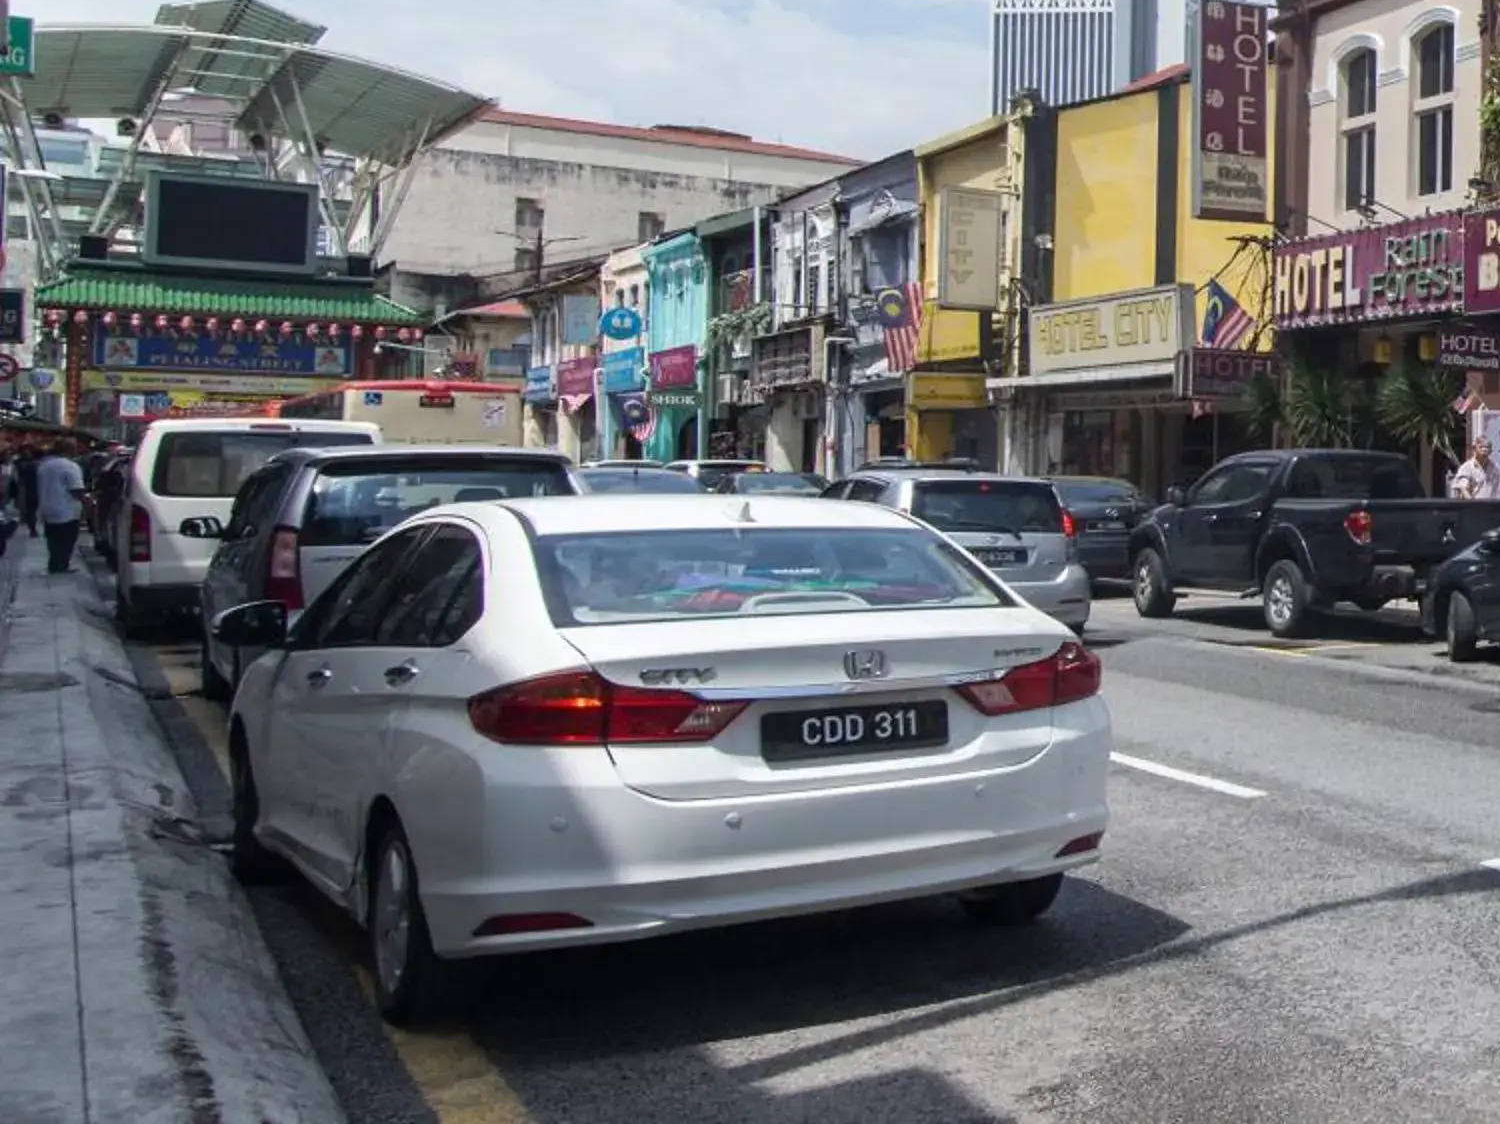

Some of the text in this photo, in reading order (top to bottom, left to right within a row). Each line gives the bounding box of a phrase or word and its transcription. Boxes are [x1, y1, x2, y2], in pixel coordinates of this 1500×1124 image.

[1233, 5, 1261, 155] HOTEL
[1386, 228, 1445, 268] Rain
[1275, 245, 1360, 316] HOTEL
[1036, 295, 1172, 356] HOTEL CITY
[1440, 333, 1498, 354] HOTEL
[802, 709, 917, 745] CDD 311
